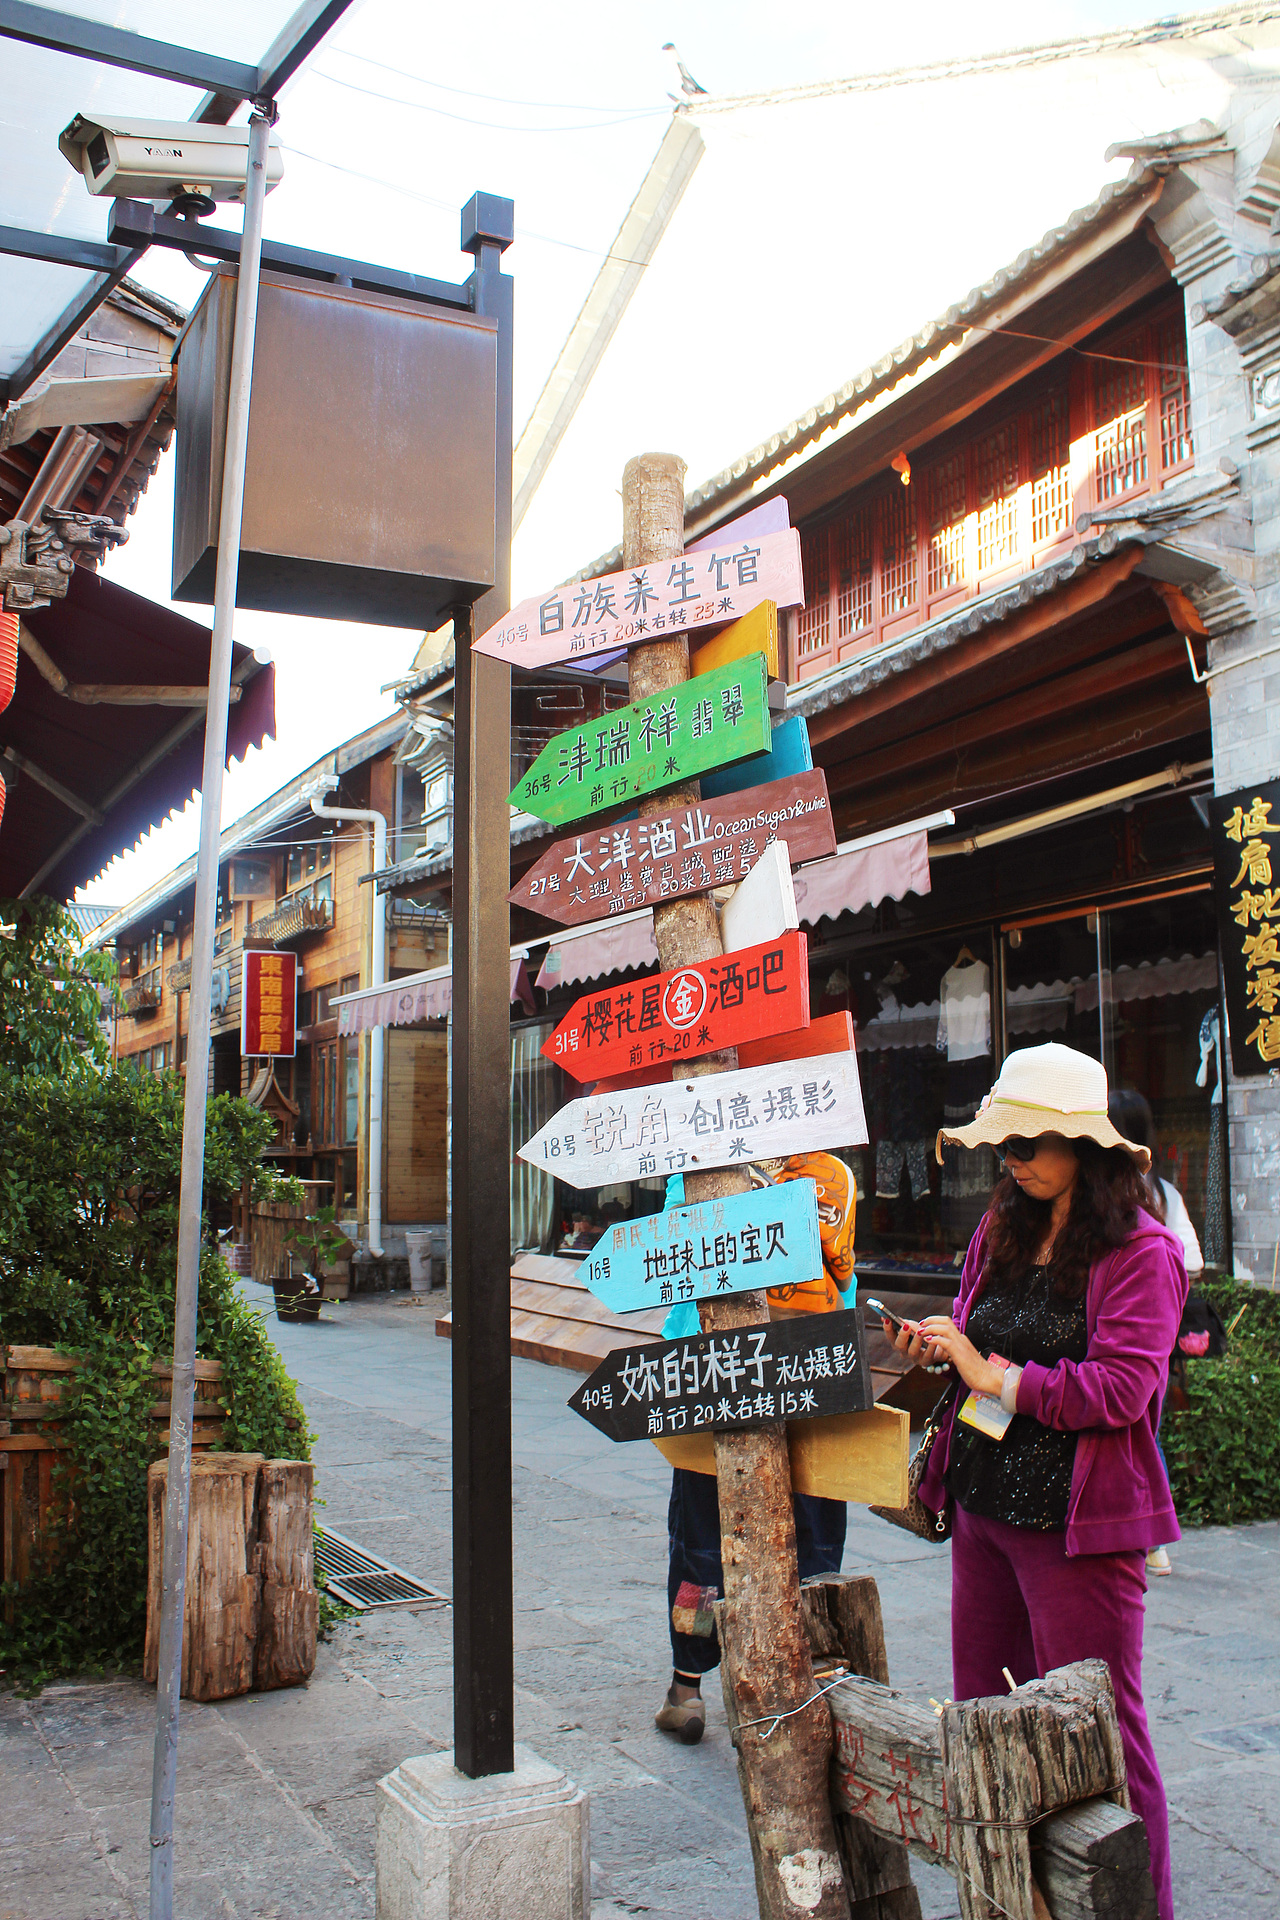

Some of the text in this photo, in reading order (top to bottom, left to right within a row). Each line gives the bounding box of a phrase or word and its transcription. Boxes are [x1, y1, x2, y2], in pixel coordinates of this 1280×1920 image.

[144, 146, 183, 158] YAAN
[539, 545, 761, 636] 白族养生馆
[496, 623, 528, 647] 46号
[525, 774, 551, 798] 36号
[563, 809, 714, 883] 大洋酒业
[529, 873, 561, 896] 27号
[1223, 797, 1280, 1062] 披肩批发零售
[555, 1028, 579, 1055] 31号
[543, 1134, 576, 1159] 18号
[643, 1221, 789, 1284] 地球上的宝贝
[589, 1257, 611, 1281] 16号
[581, 1384, 613, 1411] 40号
[647, 1388, 819, 1434] 前行20米右转15米
